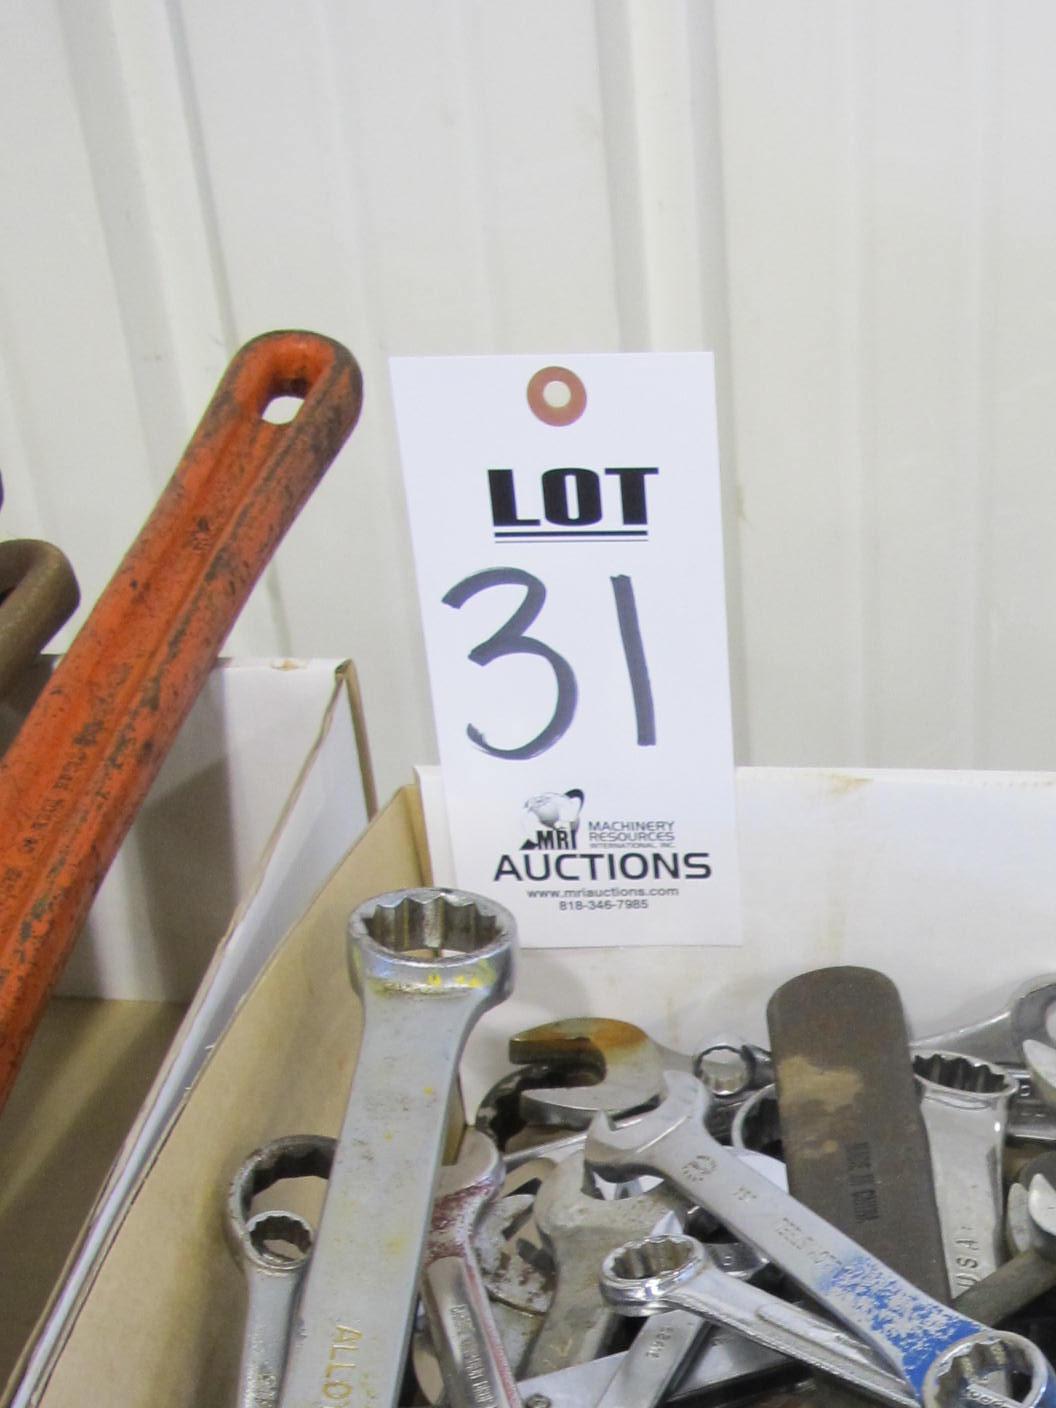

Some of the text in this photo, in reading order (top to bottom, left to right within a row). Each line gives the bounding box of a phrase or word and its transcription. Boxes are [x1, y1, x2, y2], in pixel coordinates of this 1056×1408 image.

[487, 467, 659, 527] LOT
[441, 565, 656, 761] 31
[588, 821, 676, 833] MACHINERY
[589, 832, 676, 842] RESOURCES
[536, 829, 577, 850] MRI
[494, 852, 713, 882] AUCTIONS
[526, 887, 680, 899] www.mriauctions.com
